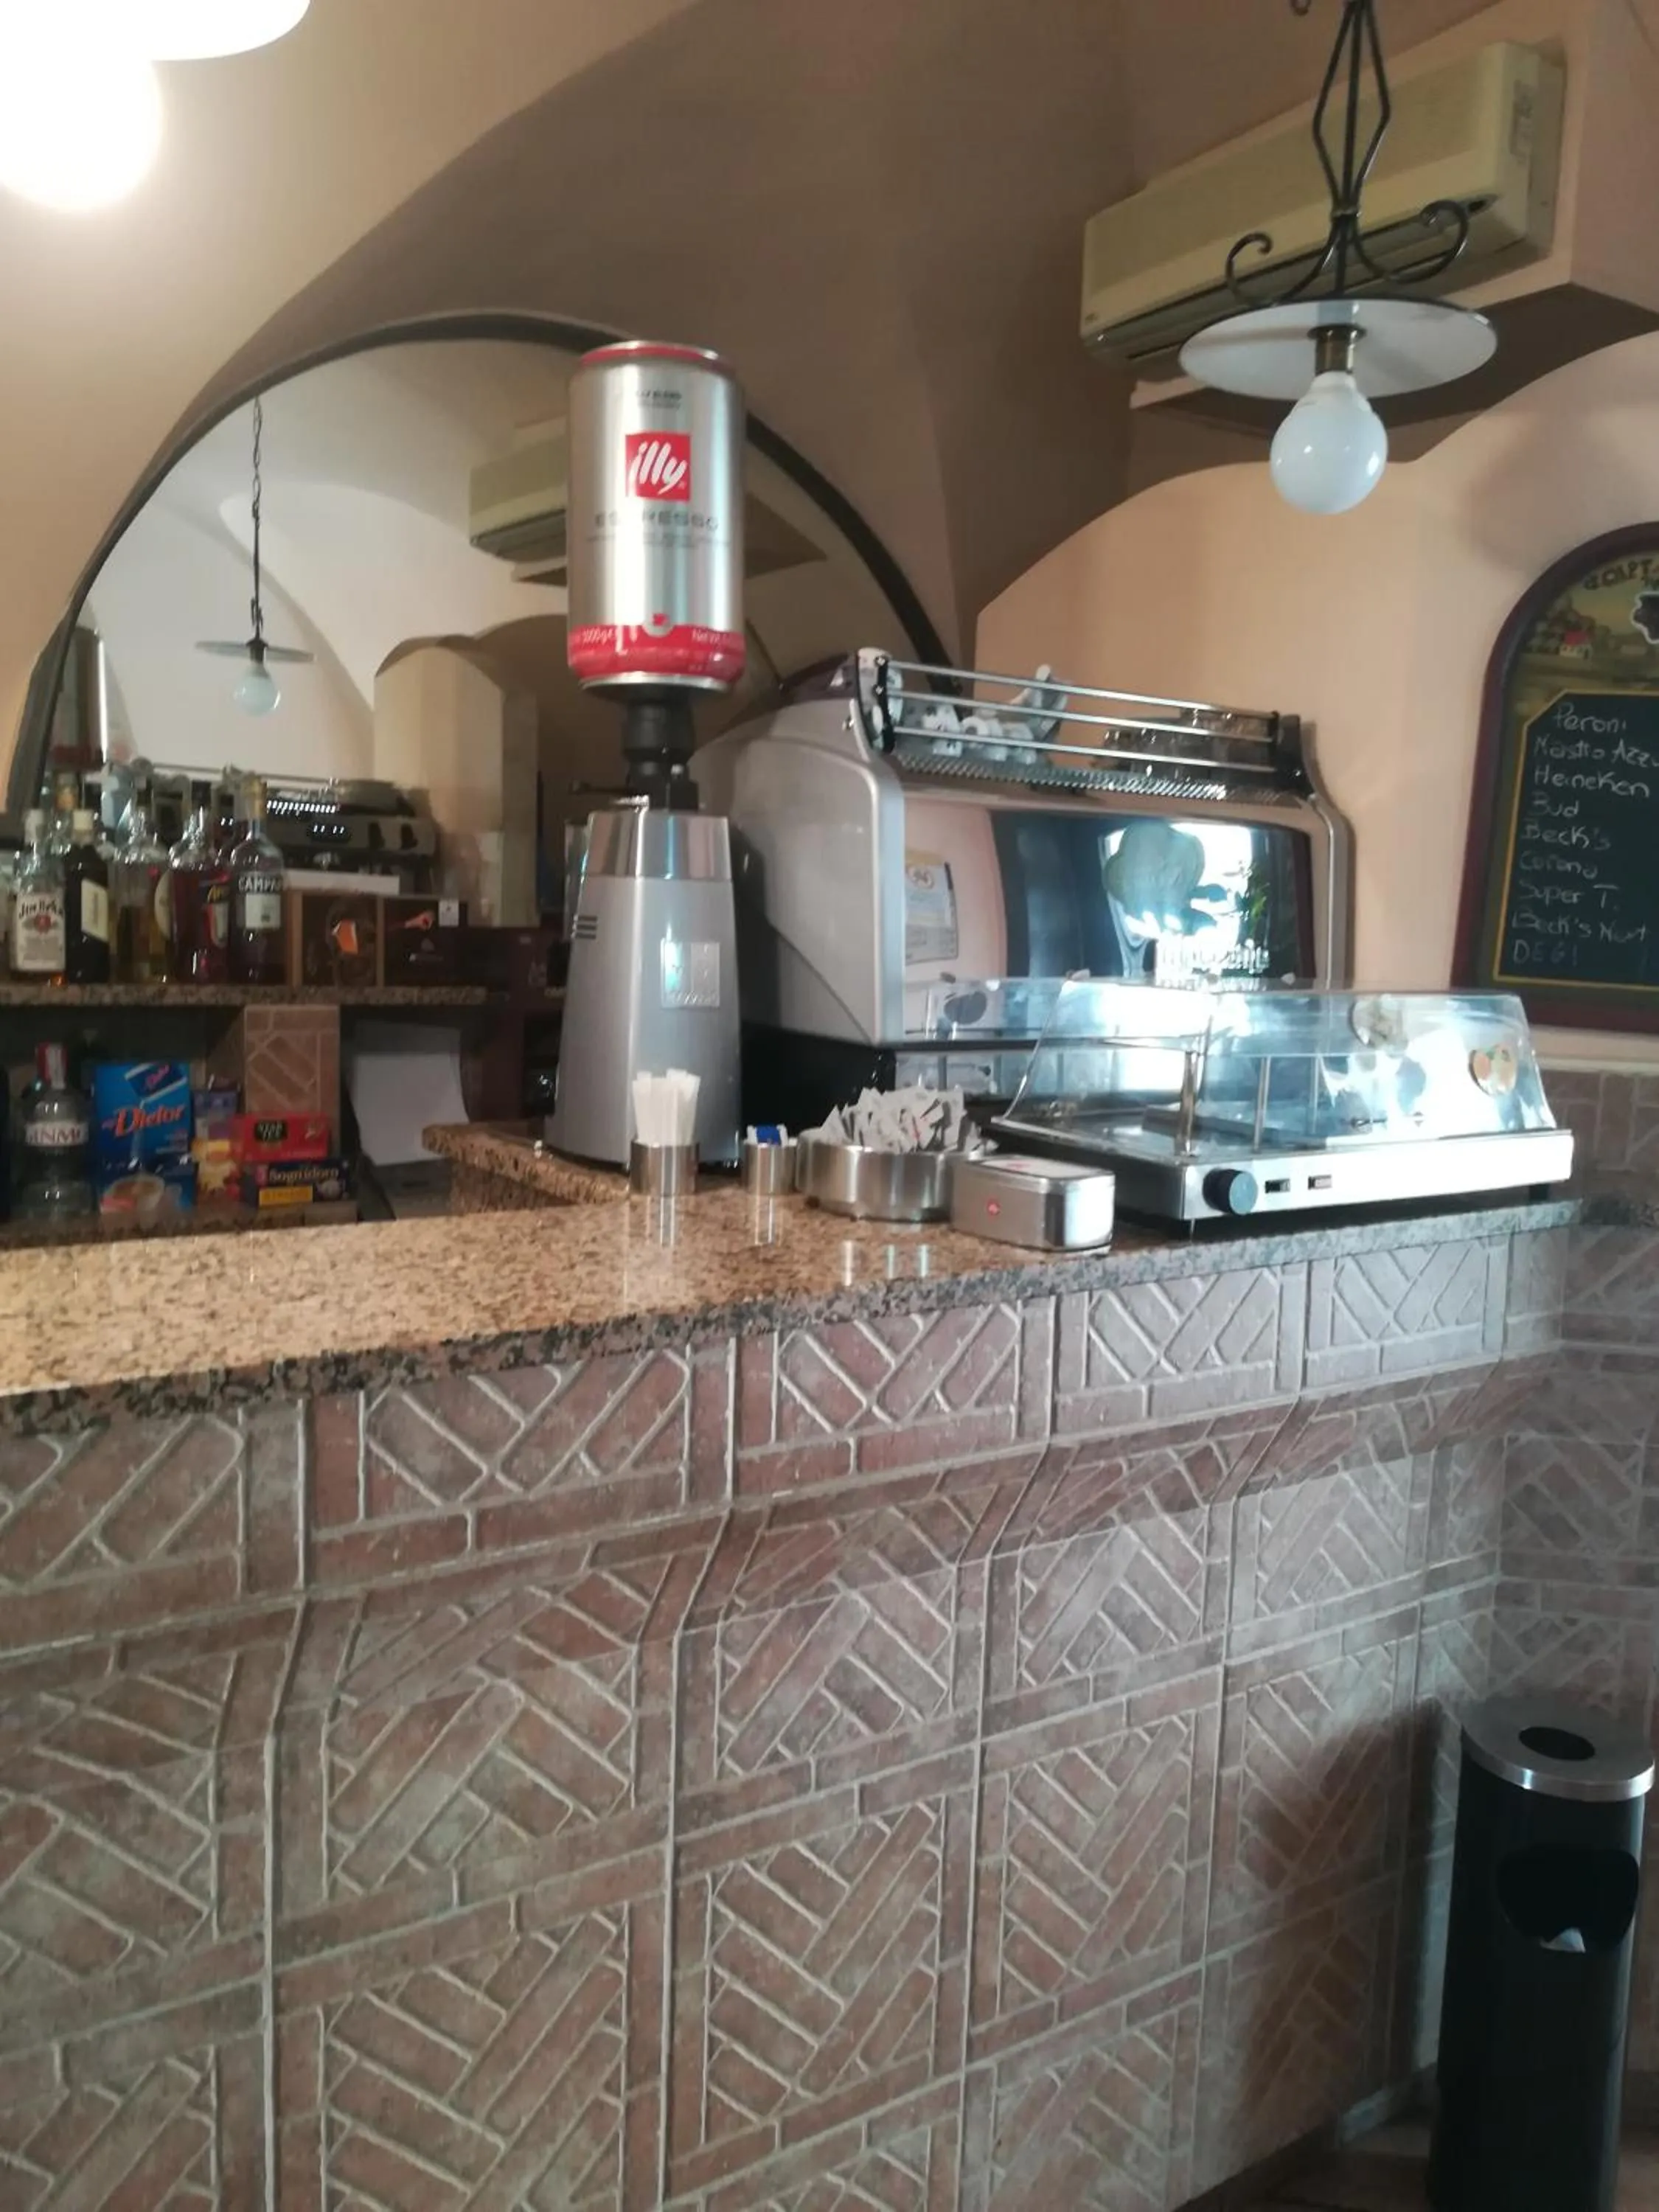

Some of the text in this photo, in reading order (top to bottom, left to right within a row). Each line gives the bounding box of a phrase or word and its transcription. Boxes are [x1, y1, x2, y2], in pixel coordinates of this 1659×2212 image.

[629, 440, 688, 495] illy
[1554, 703, 1627, 732] Peroni
[1531, 791, 1579, 817] Bud
